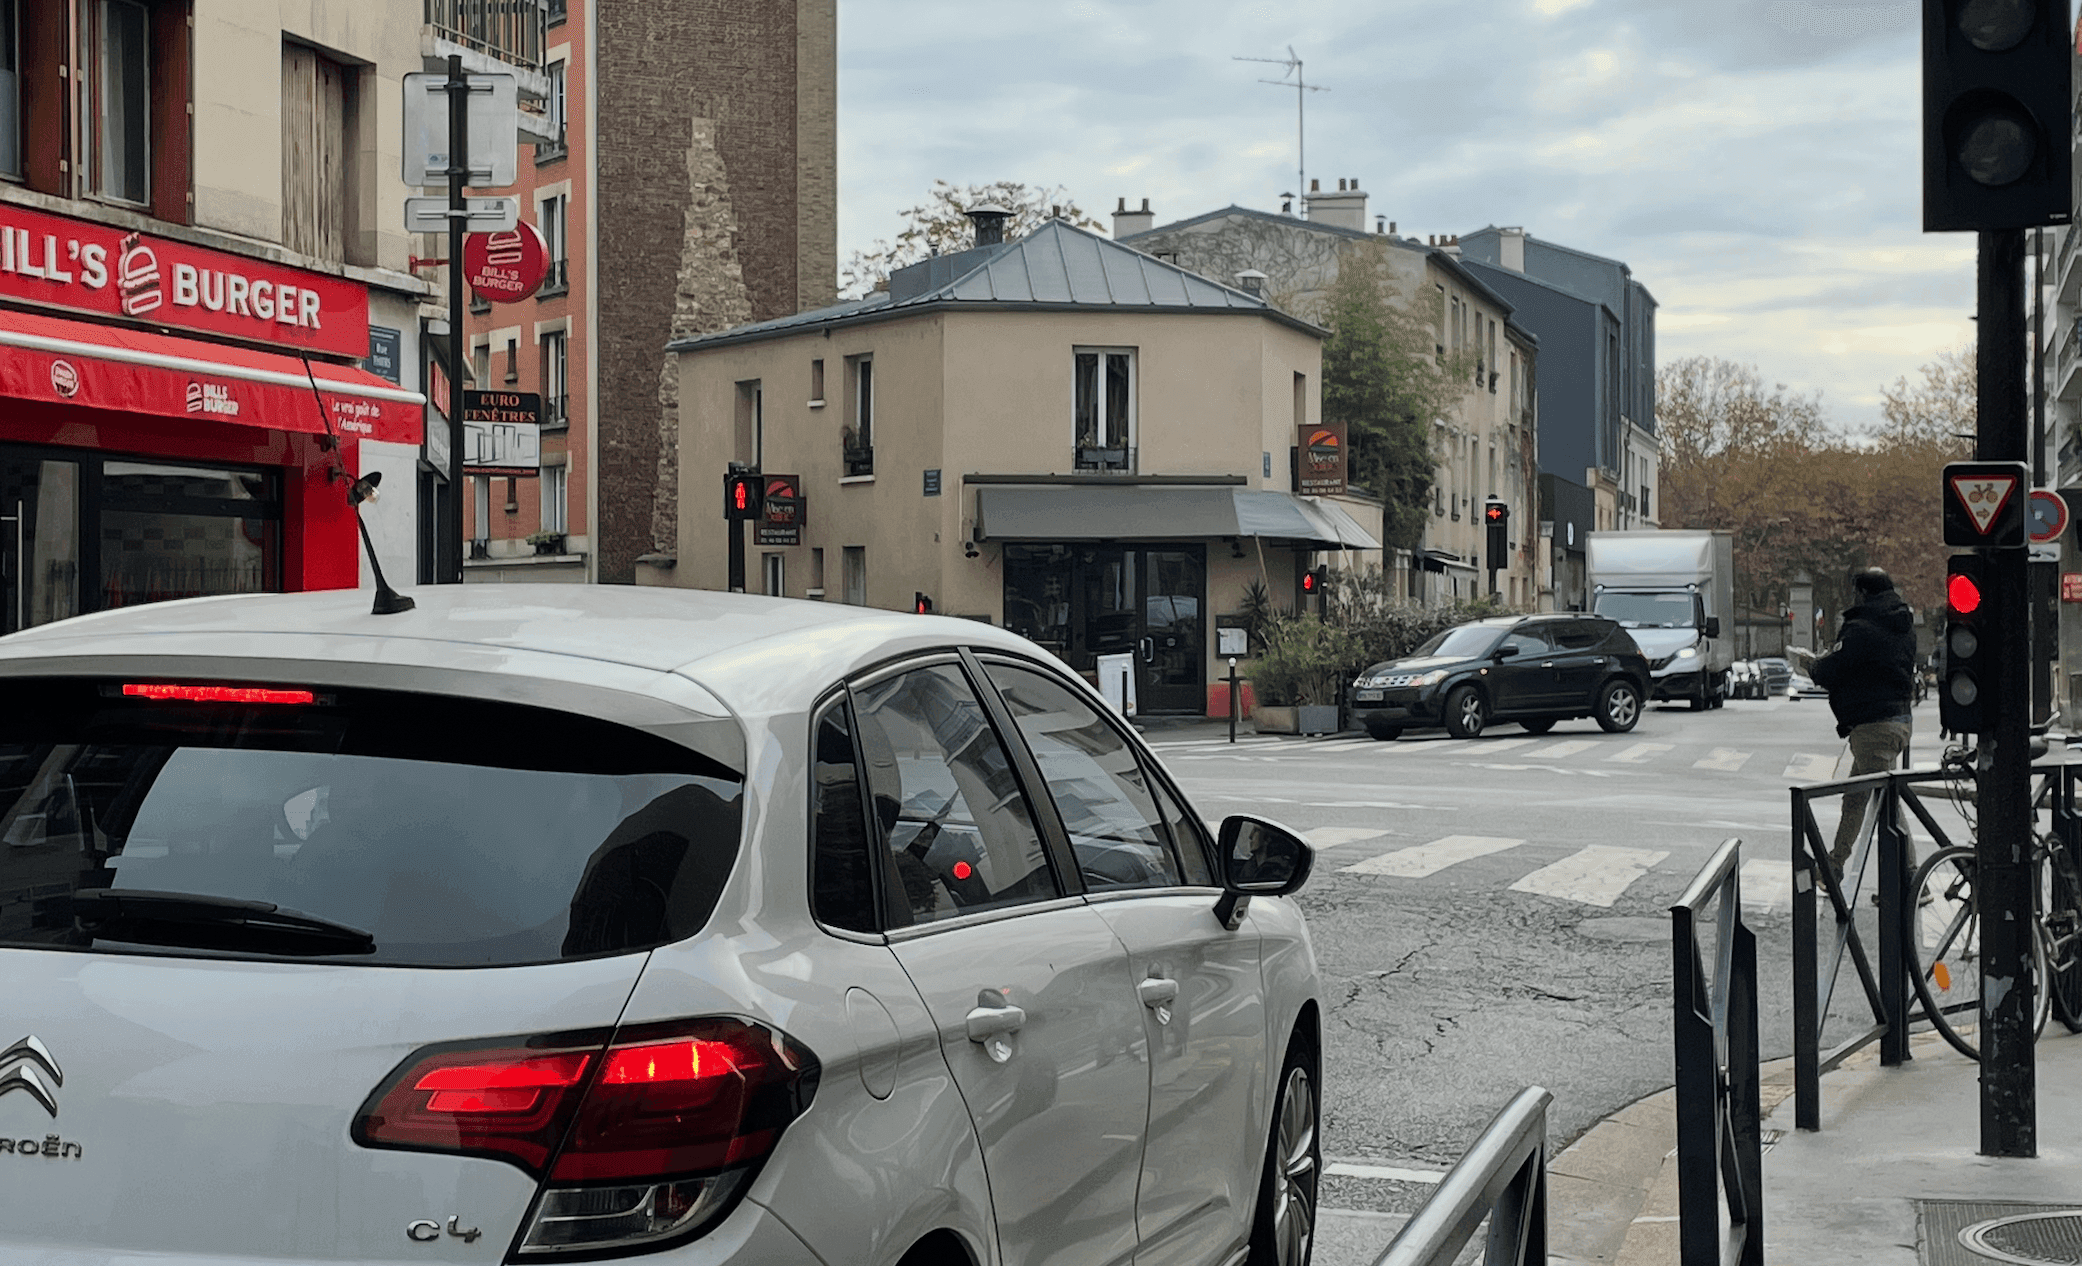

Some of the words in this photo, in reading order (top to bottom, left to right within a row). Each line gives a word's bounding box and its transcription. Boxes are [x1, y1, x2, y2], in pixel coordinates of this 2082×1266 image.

[0, 225, 108, 289] ILL'S
[172, 263, 322, 329] BURGER
[482, 266, 519, 281] BILL'S
[473, 275, 524, 292] BURGER
[203, 398, 239, 416] BURGER
[480, 394, 520, 407] EURO
[464, 407, 537, 422] FENÊTRES
